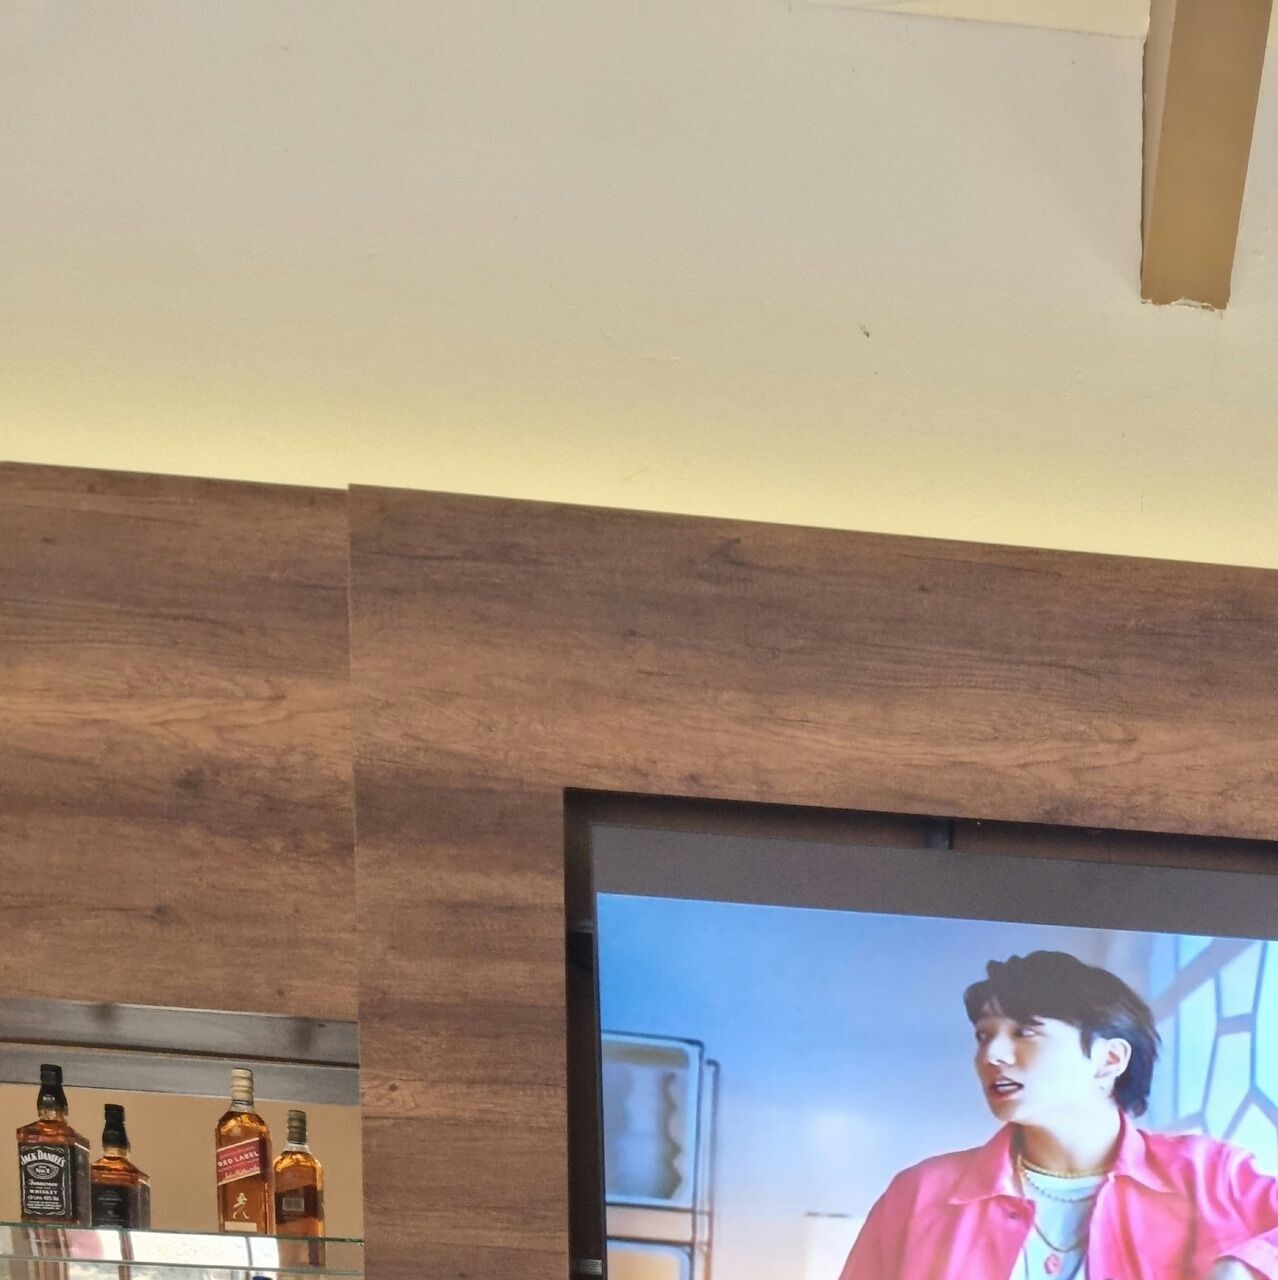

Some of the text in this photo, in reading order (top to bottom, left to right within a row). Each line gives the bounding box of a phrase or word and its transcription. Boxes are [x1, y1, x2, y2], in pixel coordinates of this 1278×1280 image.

[21, 1149, 67, 1168] JACK DANIEL'S
[217, 1158, 233, 1167] RED
[234, 1150, 260, 1162] LABEL
